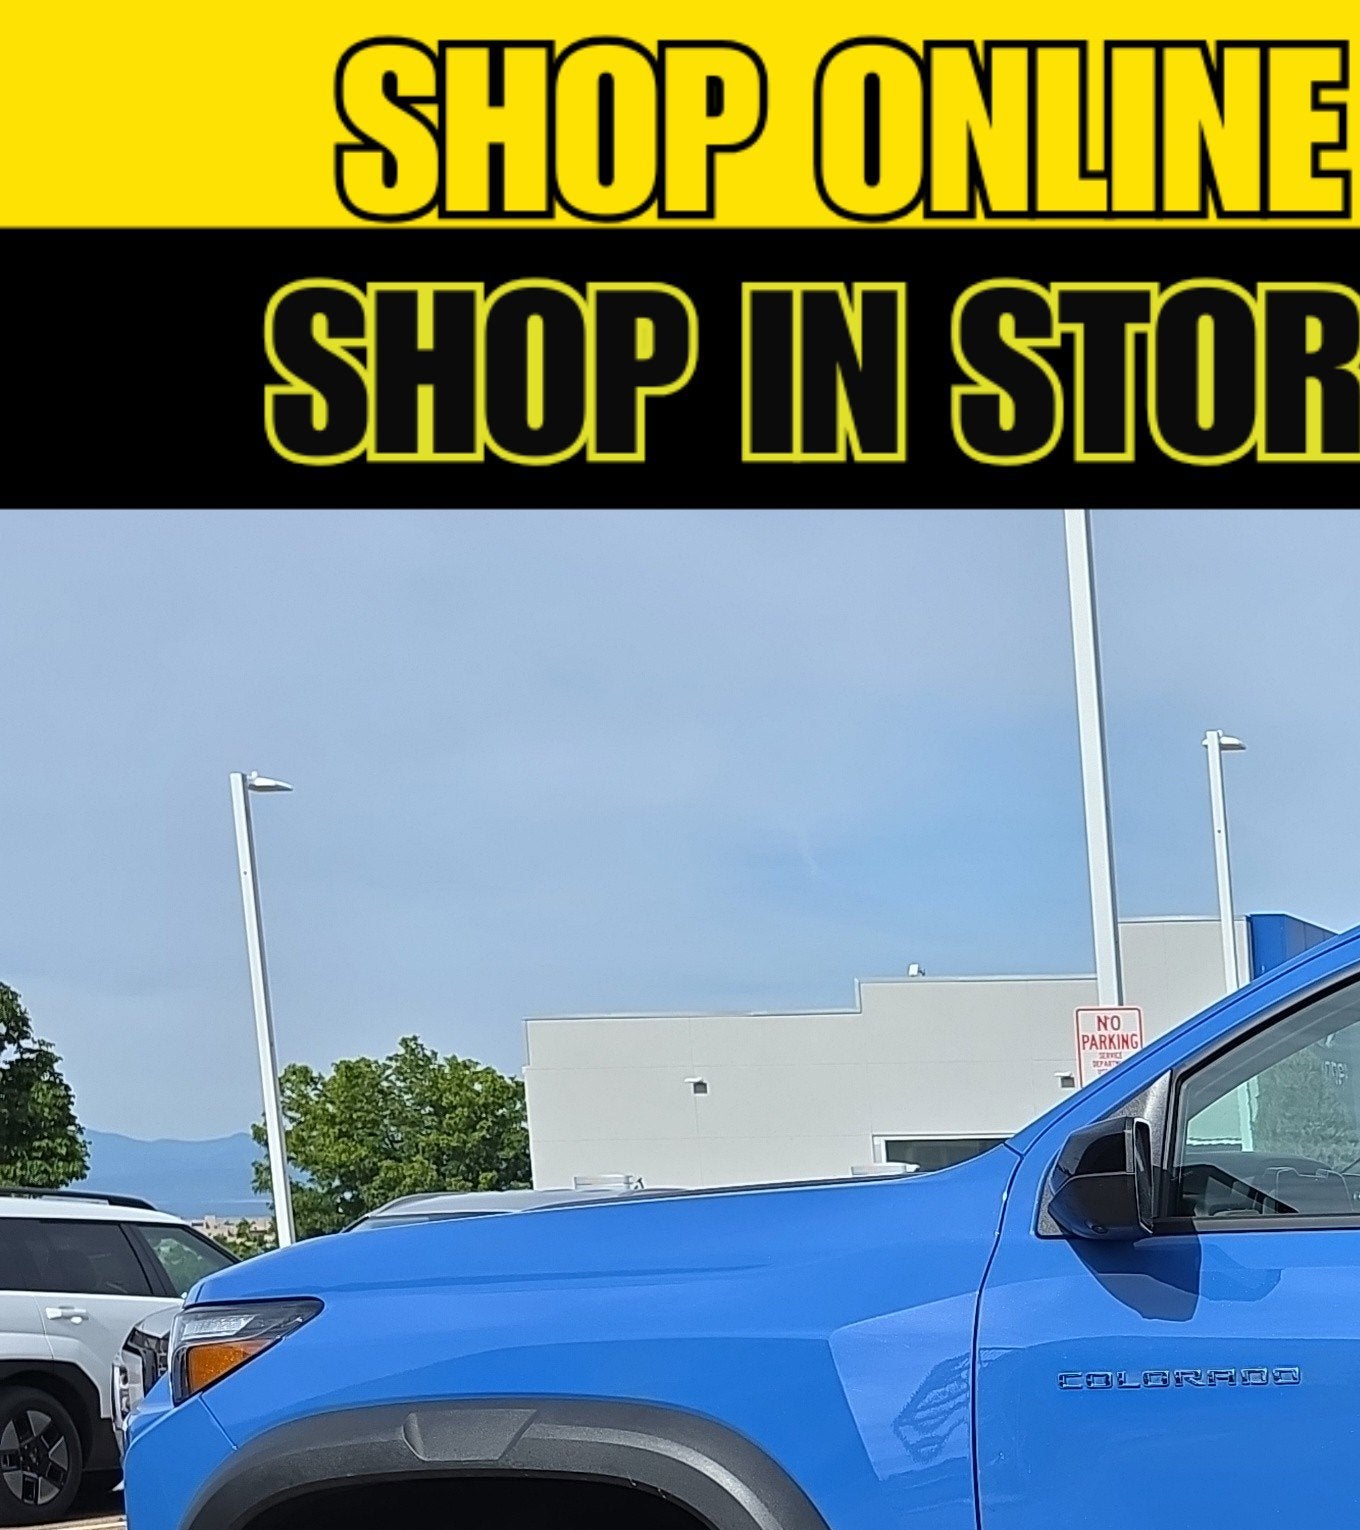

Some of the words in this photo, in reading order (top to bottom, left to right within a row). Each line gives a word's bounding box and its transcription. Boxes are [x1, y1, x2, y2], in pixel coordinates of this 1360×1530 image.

[1096, 1015, 1121, 1032] NO
[1081, 1033, 1139, 1050] PARKING
[1057, 1366, 1301, 1390] COLORADO
